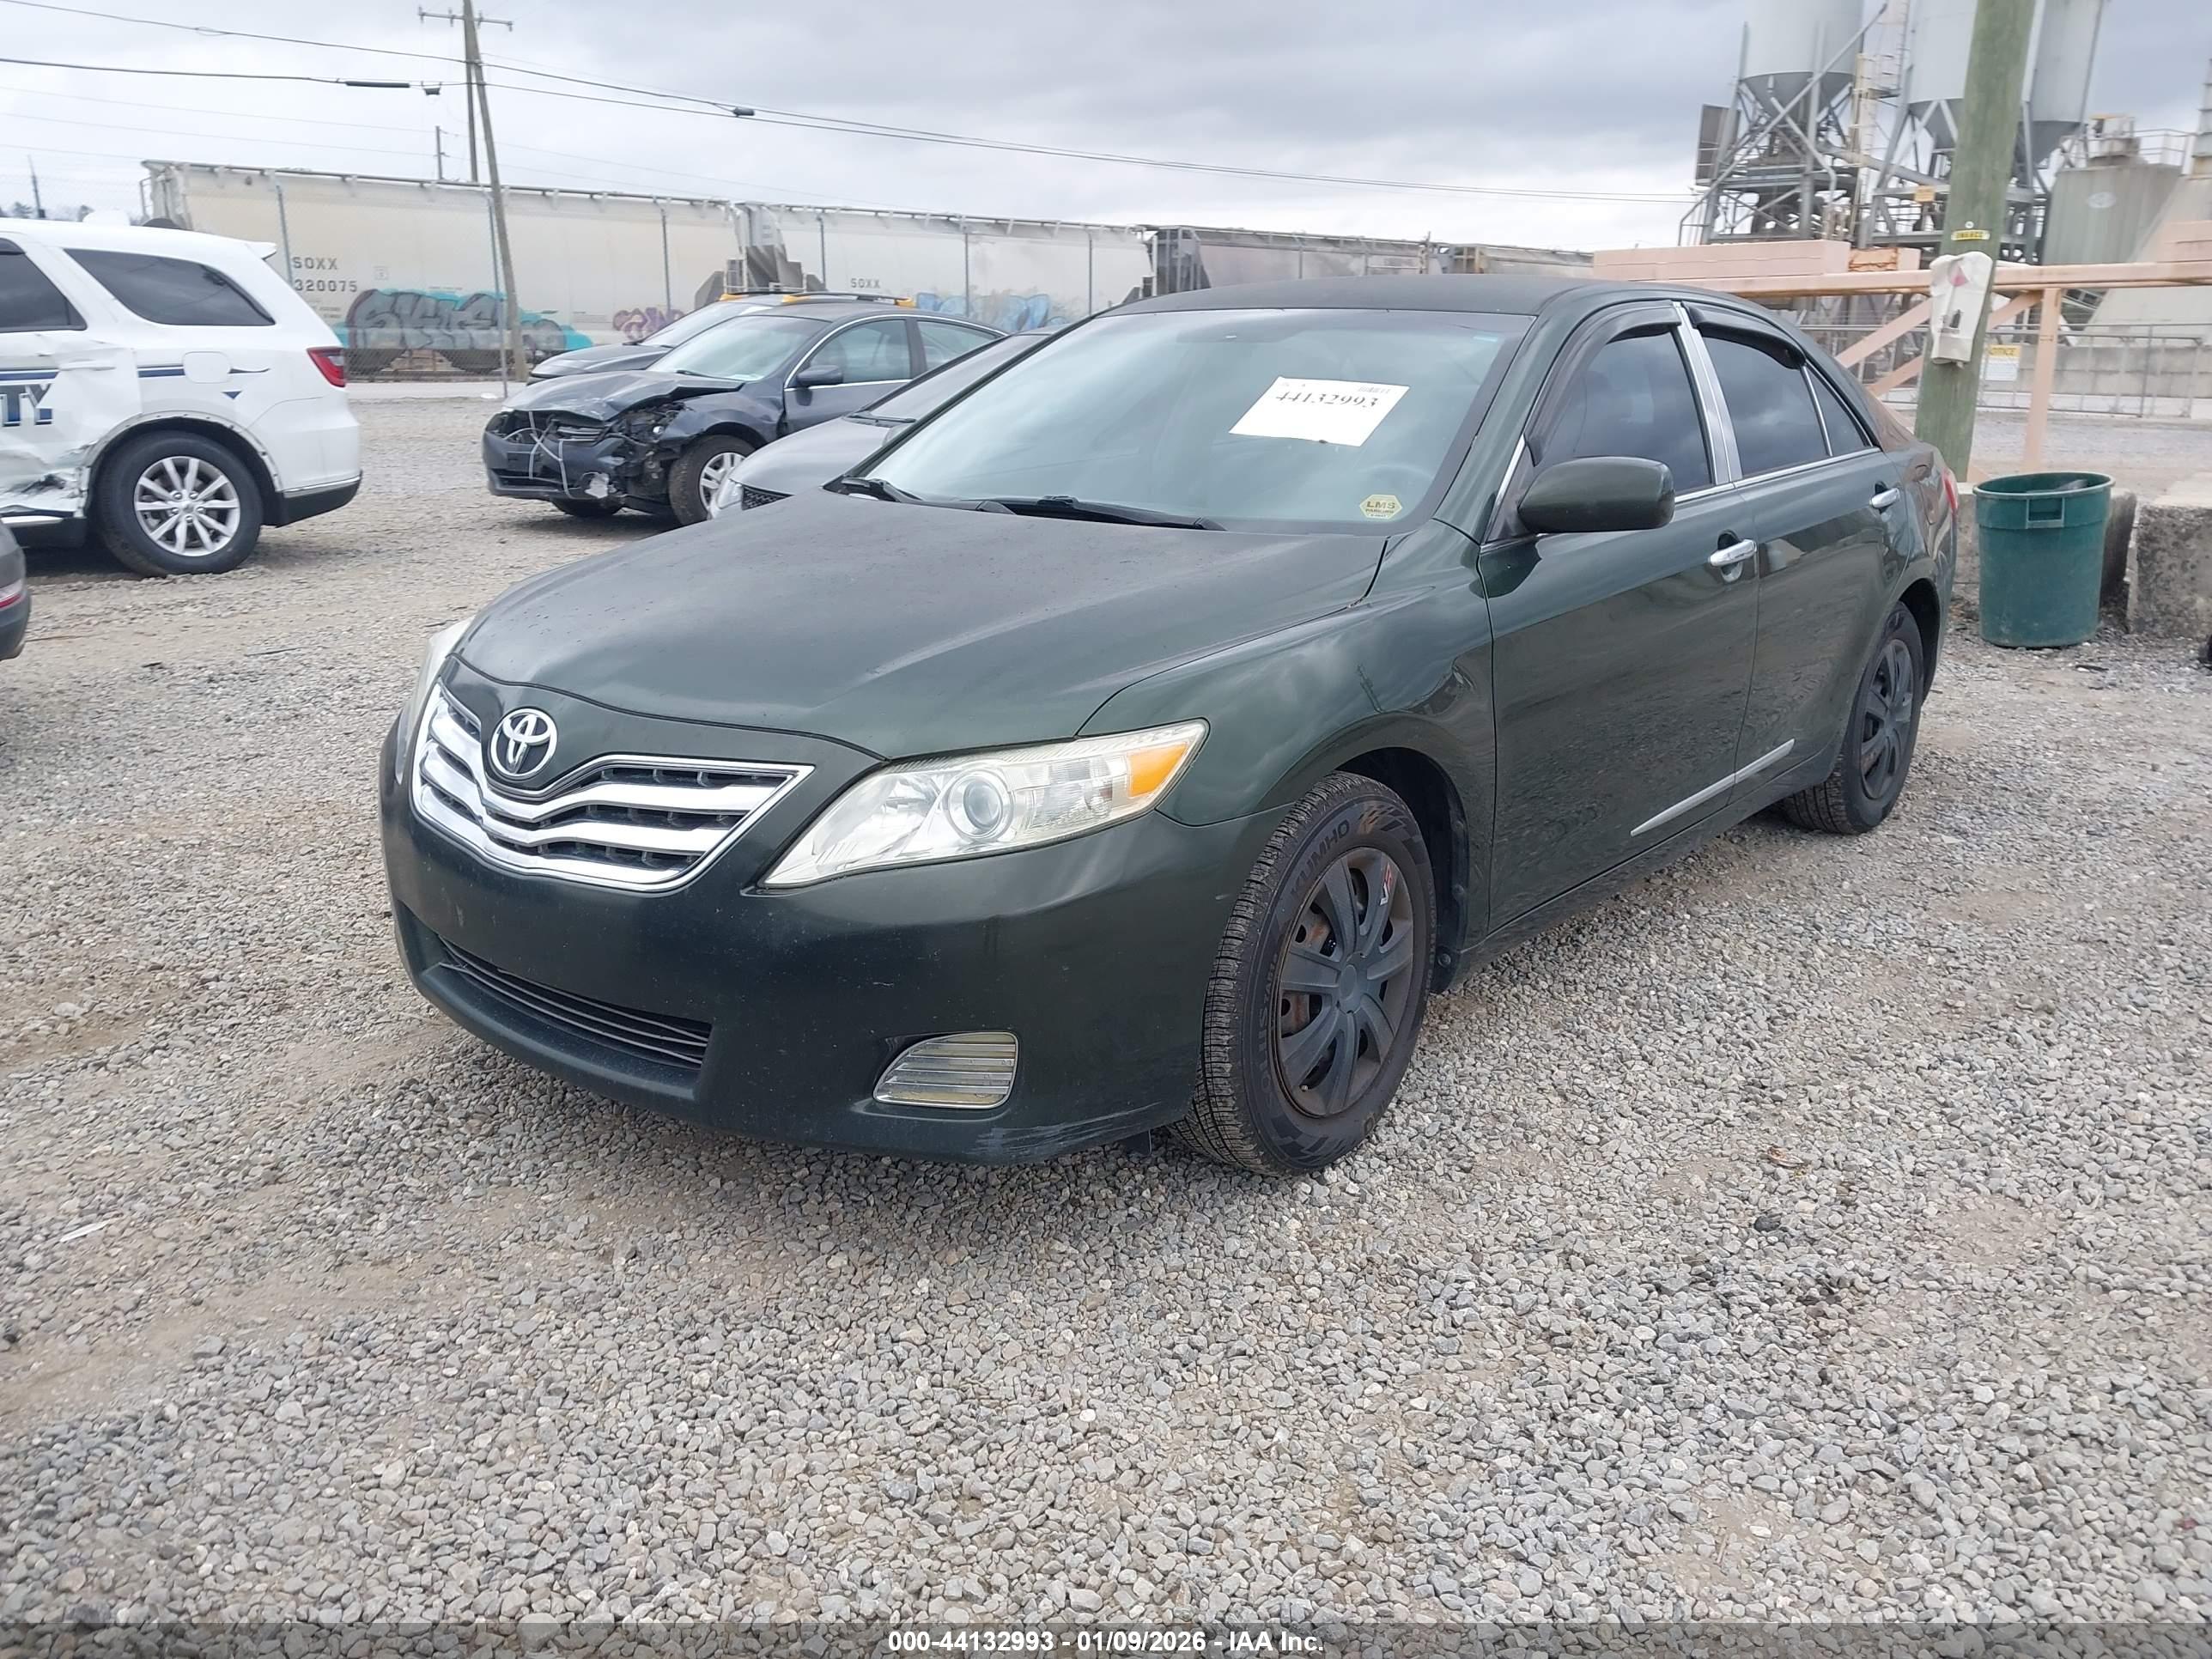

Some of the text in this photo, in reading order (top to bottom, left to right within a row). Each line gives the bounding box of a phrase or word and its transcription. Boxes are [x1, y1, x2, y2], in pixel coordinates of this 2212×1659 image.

[292, 257, 338, 270] SOXX
[294, 279, 358, 293] 320075
[850, 277, 881, 289] SOXX
[1276, 391, 1380, 409] 44132993
[1366, 501, 1395, 509] LMS
[1291, 818, 1351, 896] KUMHO
